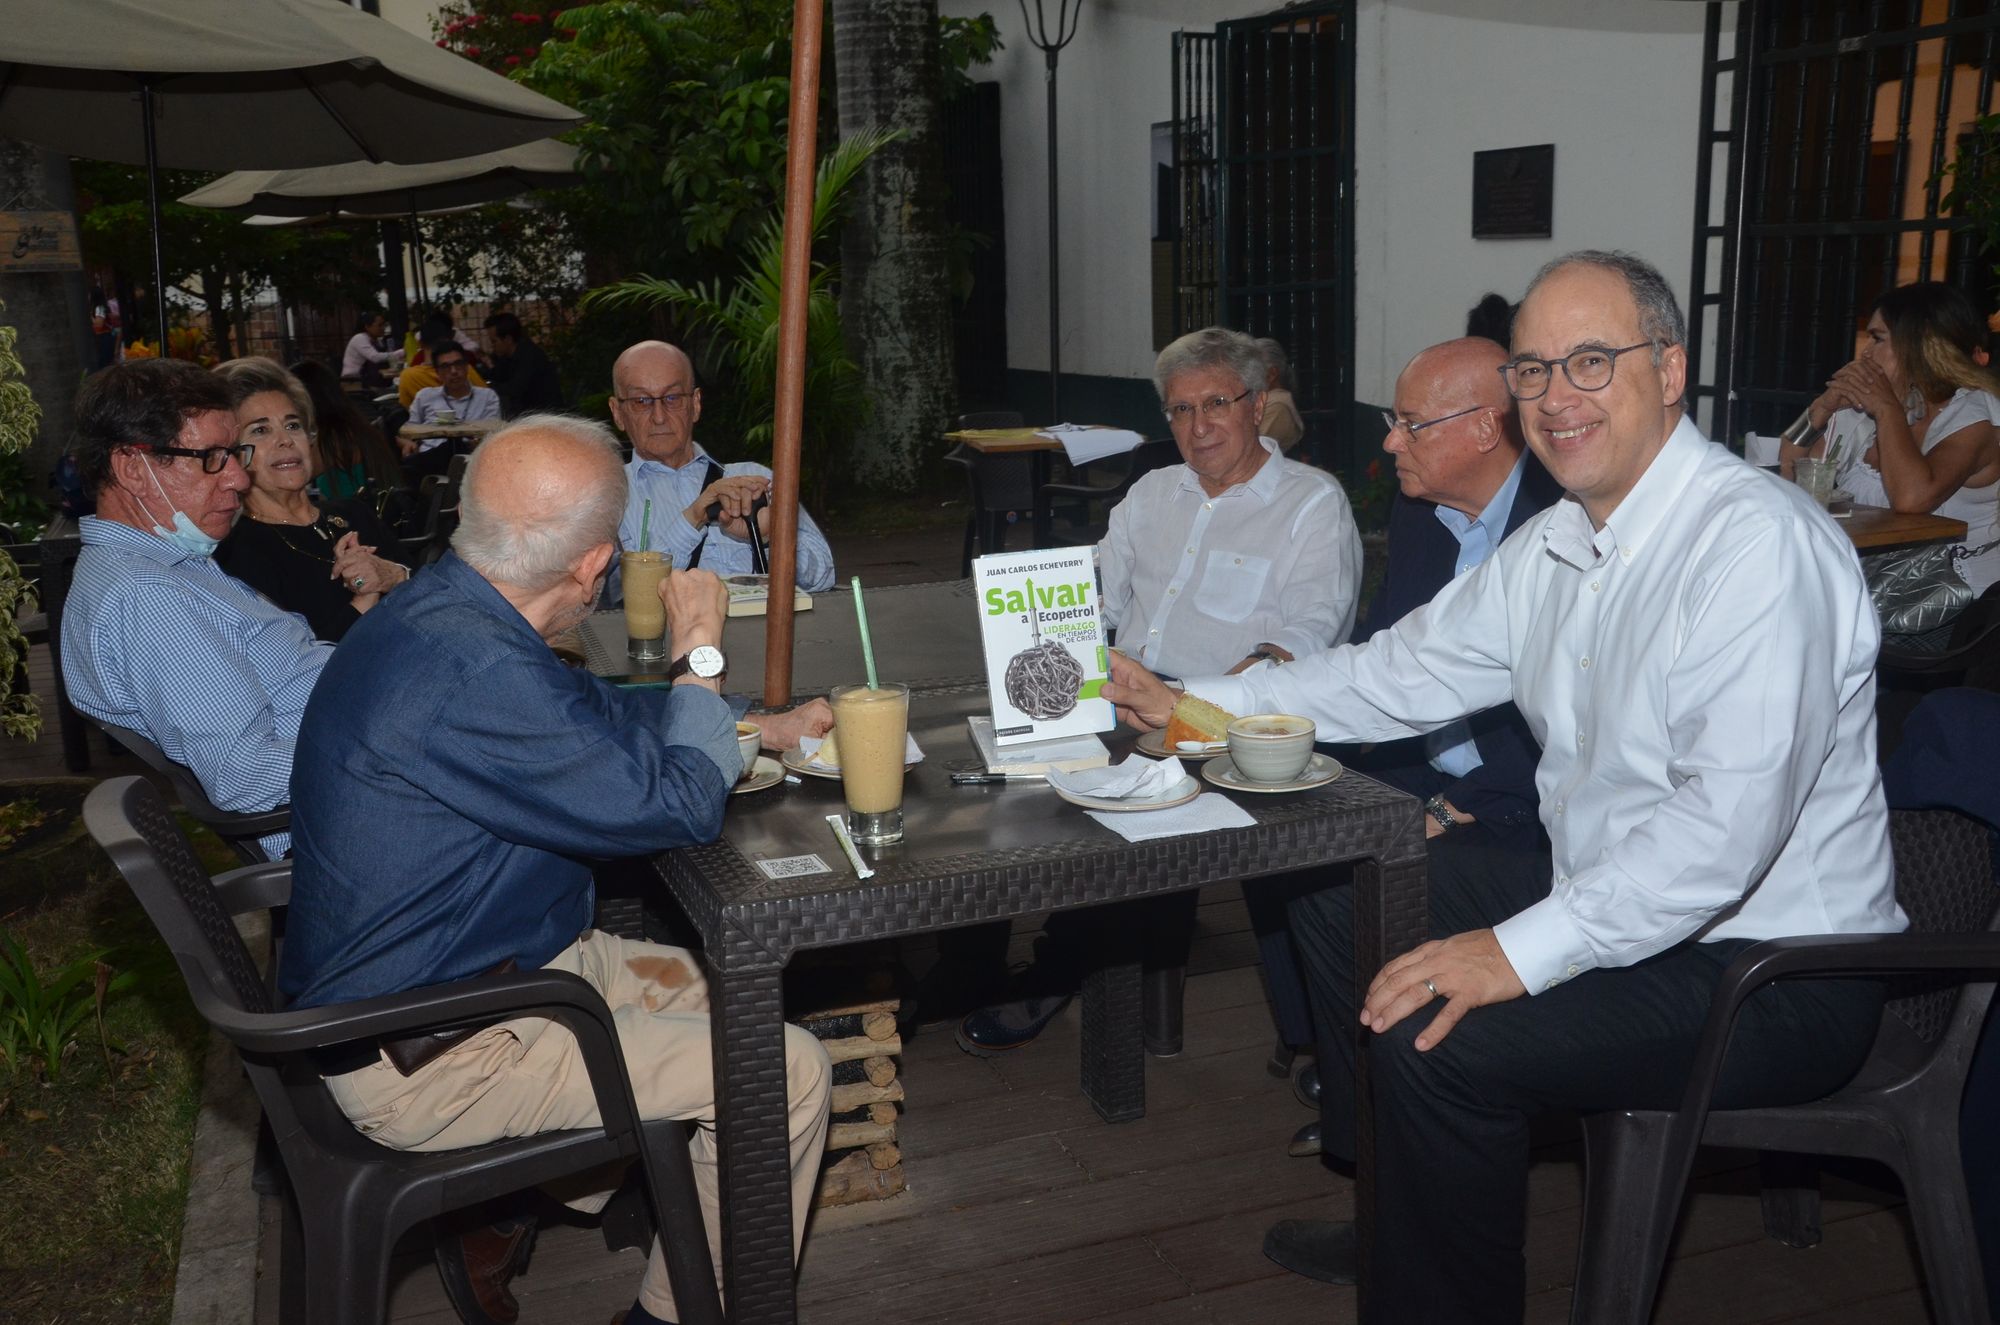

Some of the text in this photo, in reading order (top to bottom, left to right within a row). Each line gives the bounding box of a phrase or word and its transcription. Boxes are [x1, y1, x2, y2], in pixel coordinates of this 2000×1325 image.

[986, 559, 1084, 577] JUAN CARLOS ECHEVERRY
[985, 577, 1091, 616] Salvar
[1021, 605, 1095, 624] a Ecopetrol
[1044, 621, 1096, 635] LIDERAZGO
[1067, 629, 1097, 638] TIEMPOS
[1076, 634, 1098, 642] CRISIS
